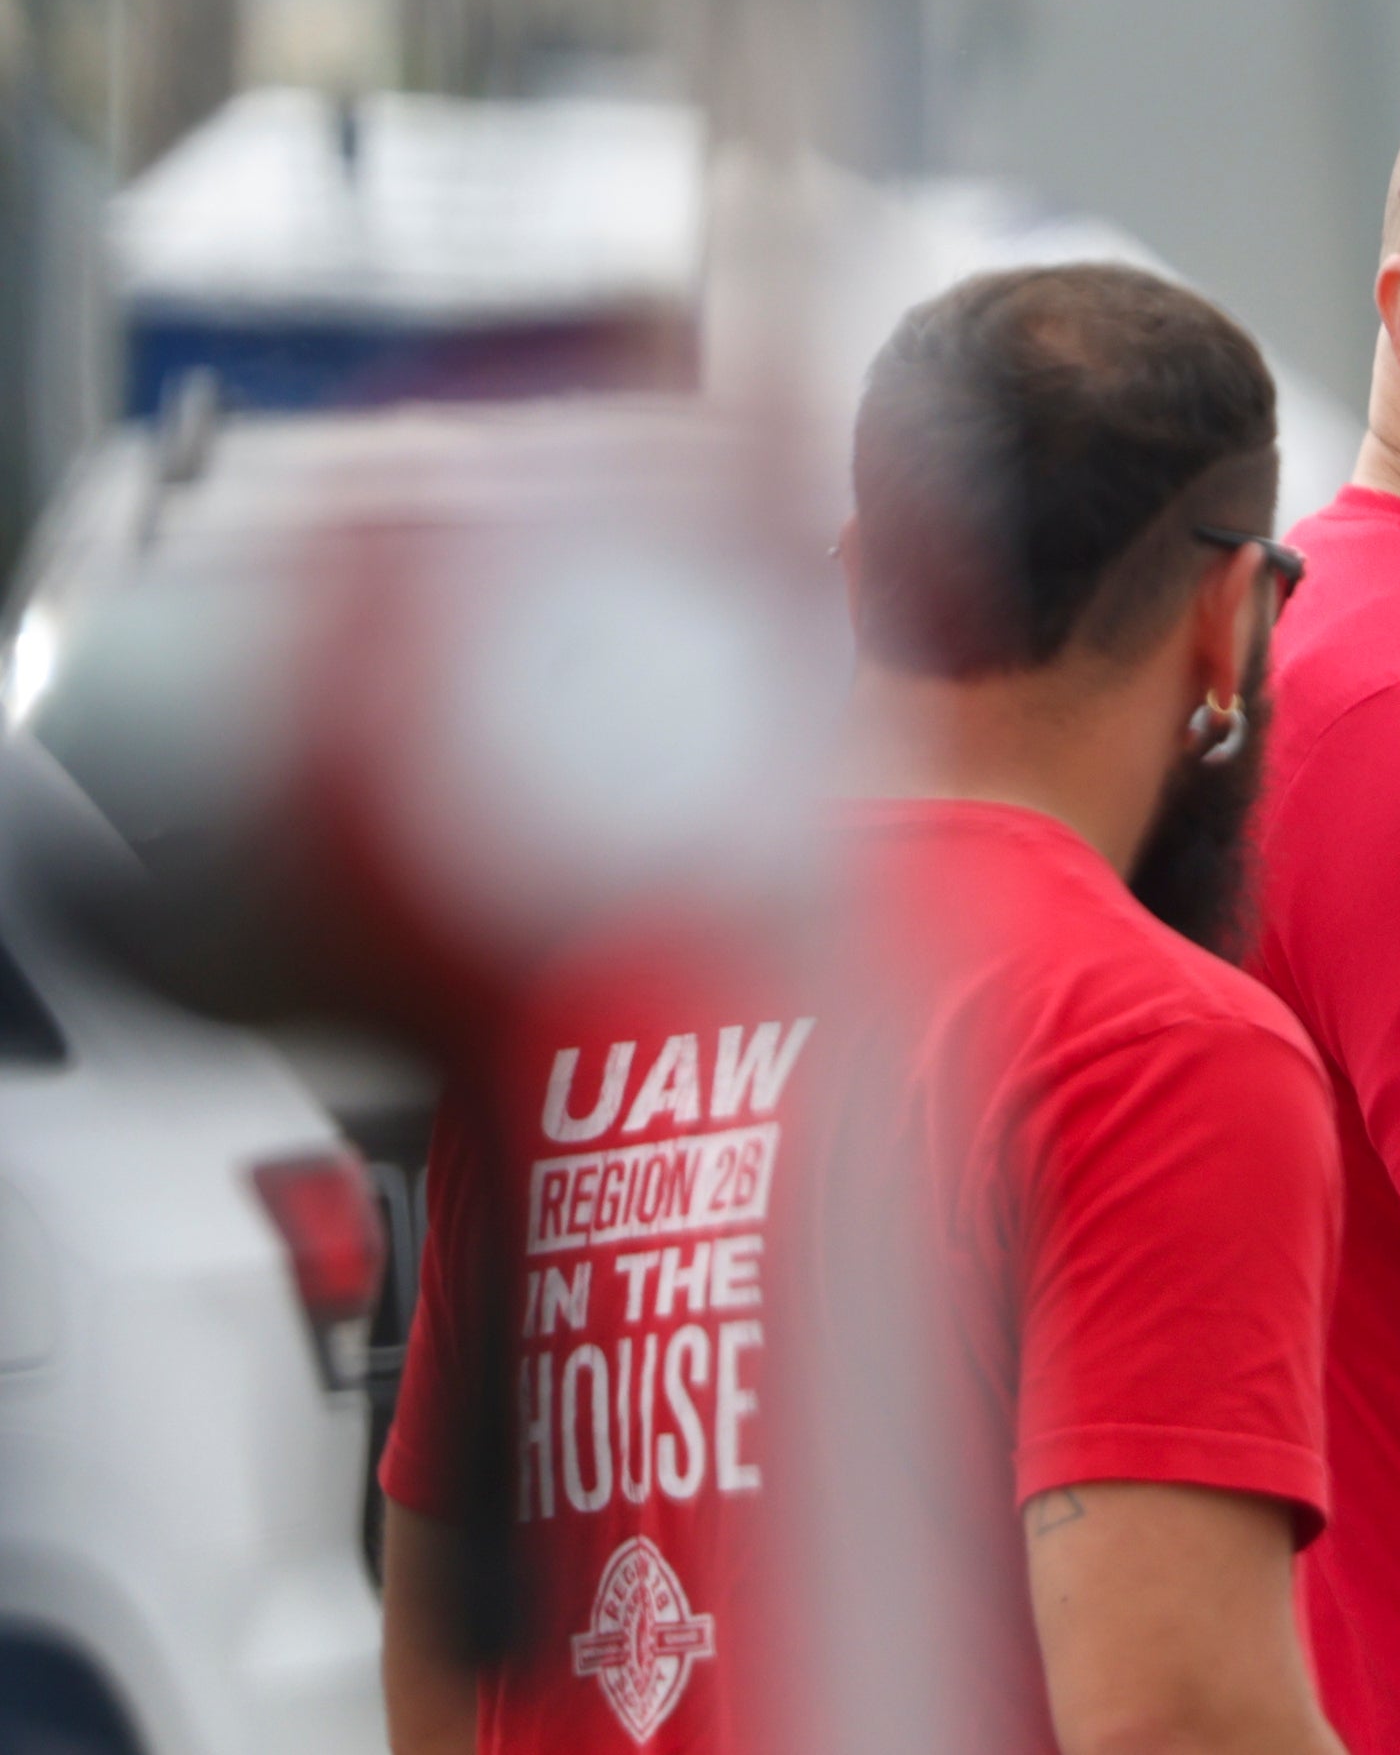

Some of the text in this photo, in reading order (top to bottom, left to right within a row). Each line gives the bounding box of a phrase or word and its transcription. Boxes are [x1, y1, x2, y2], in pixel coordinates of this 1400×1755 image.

[541, 1016, 817, 1142] UAW
[538, 1136, 764, 1241] REGION 2B
[522, 1233, 764, 1339] IN THE
[517, 1318, 765, 1523] HOUSE
